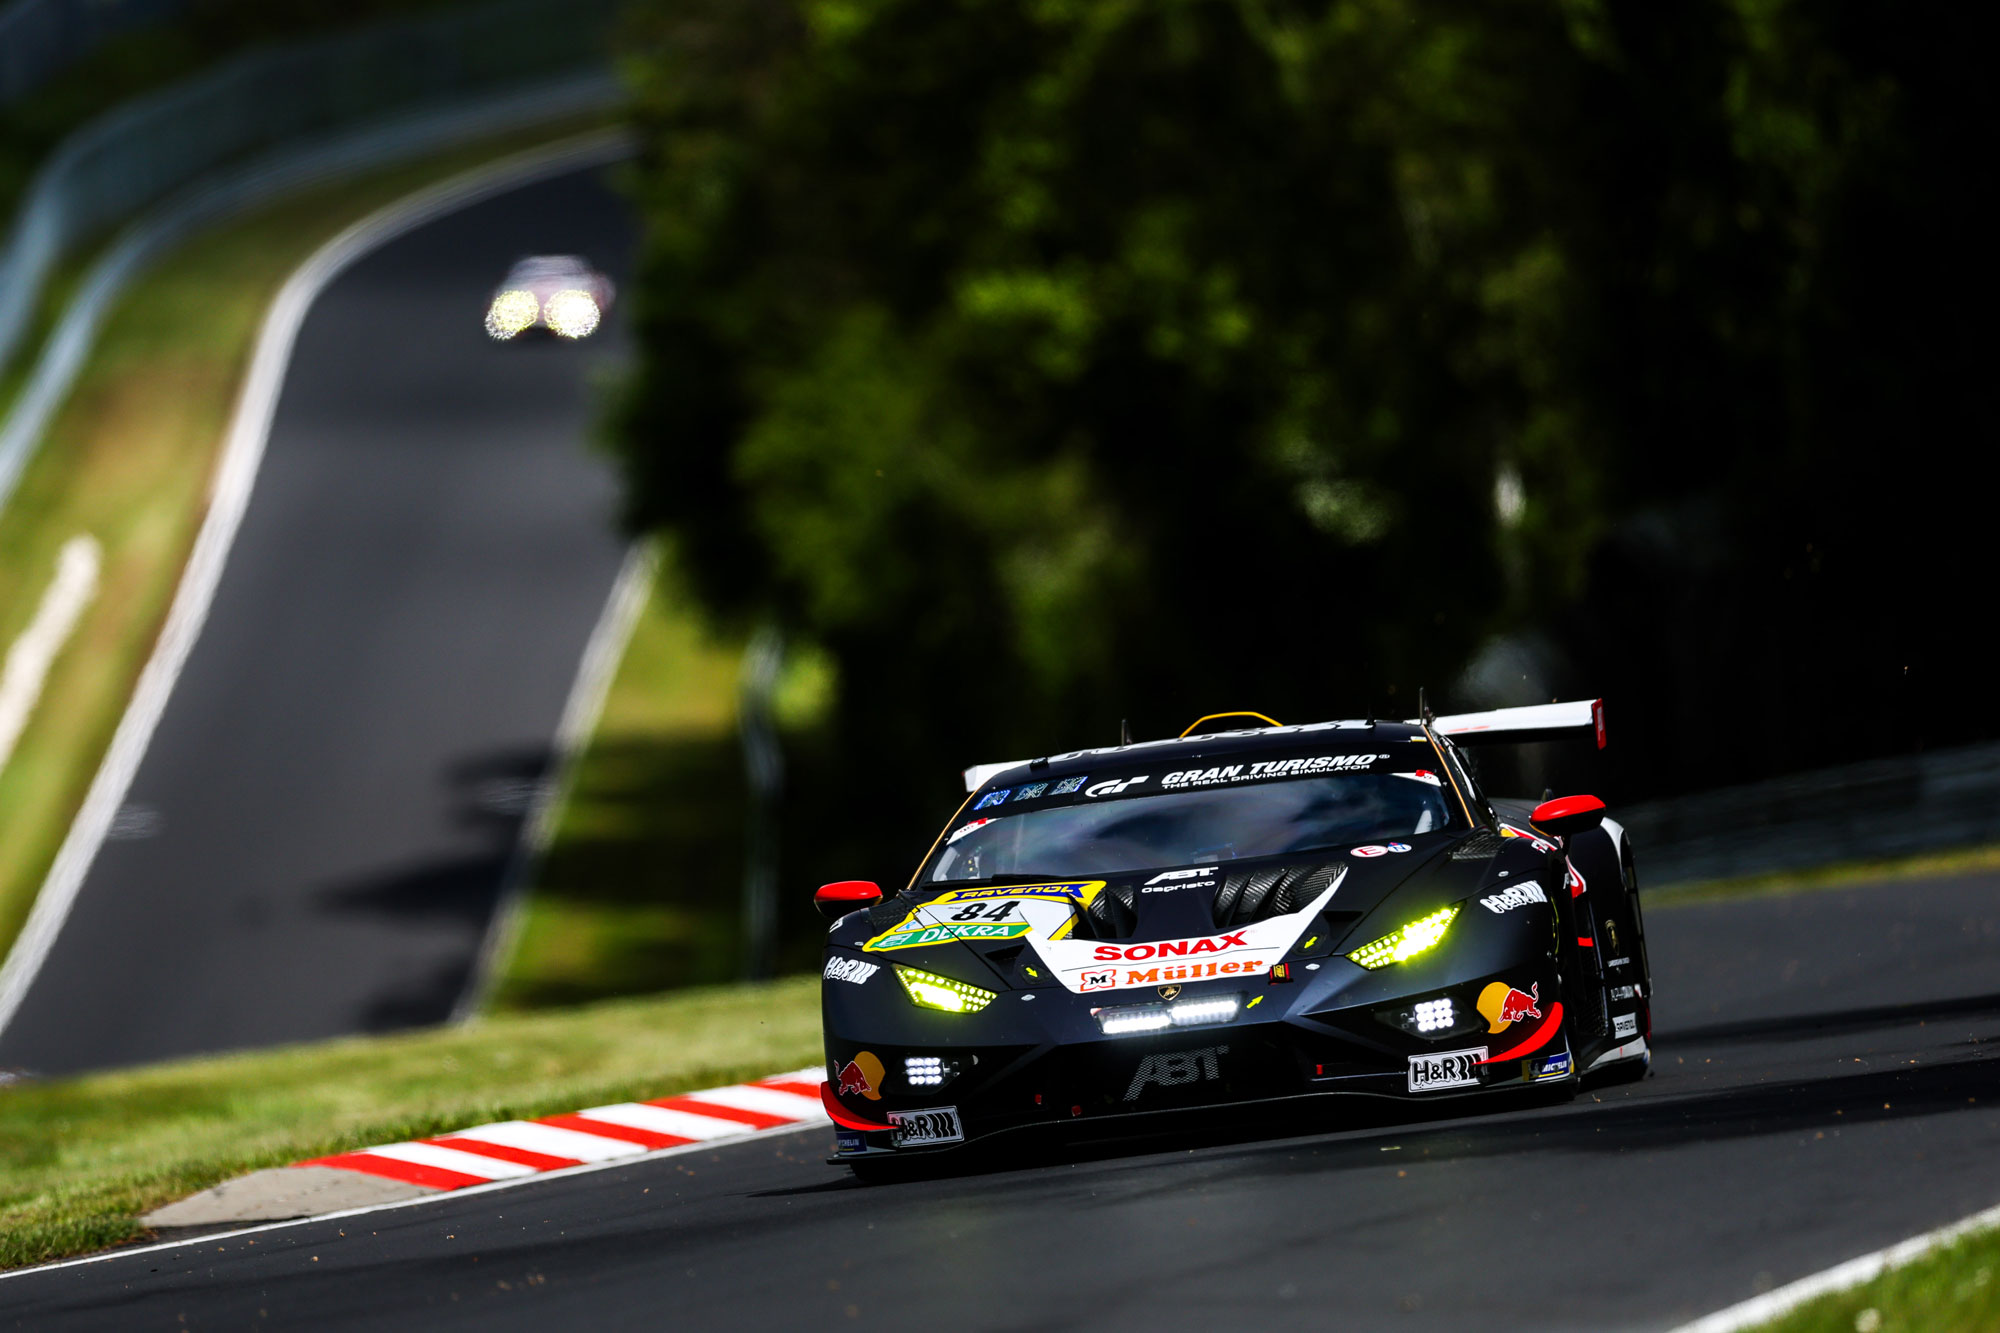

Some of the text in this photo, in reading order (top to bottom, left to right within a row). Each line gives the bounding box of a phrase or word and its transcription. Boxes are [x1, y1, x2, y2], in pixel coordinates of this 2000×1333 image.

[1161, 764, 1244, 785] GRAN
[1162, 764, 1371, 790] THE REAL DRIVING SIMULATOR
[1144, 867, 1219, 886] ABT
[959, 885, 1075, 899] RAVENOL
[950, 900, 1021, 922] 84
[917, 925, 1009, 943] DEKRA
[1093, 930, 1248, 961] SONAX
[1125, 960, 1264, 985] Müller
[1122, 1046, 1220, 1101] ABT
[1412, 1057, 1460, 1086] H&R
